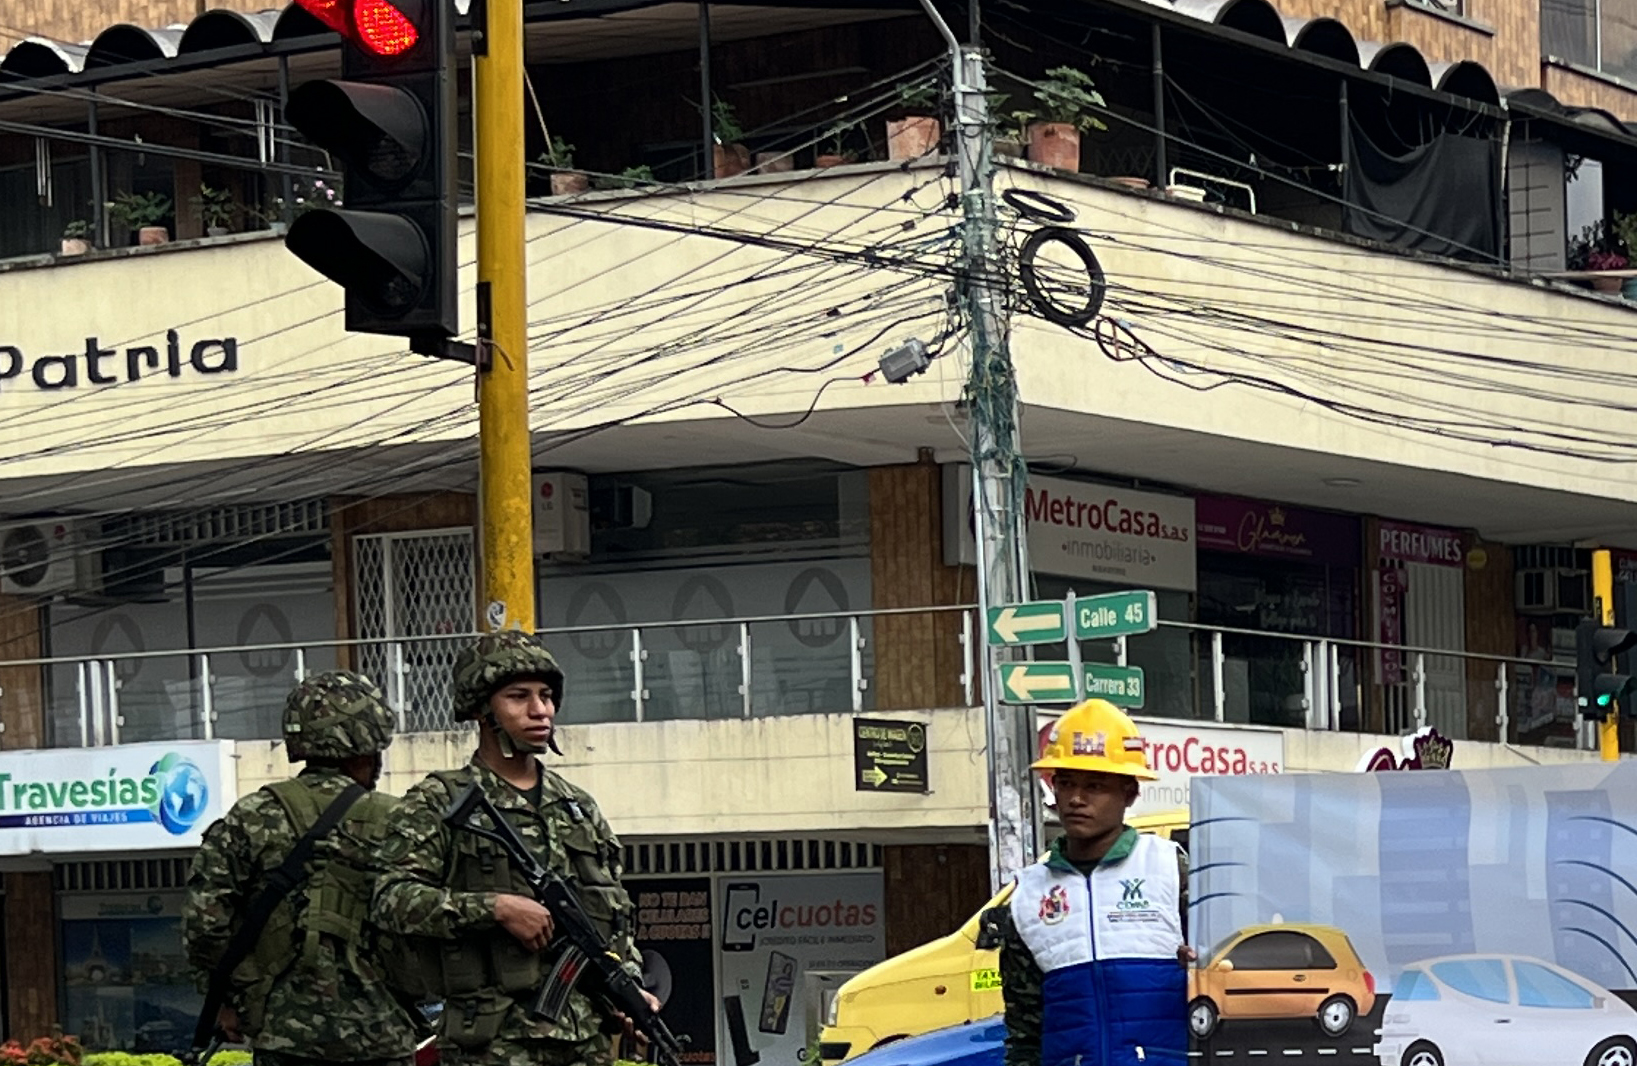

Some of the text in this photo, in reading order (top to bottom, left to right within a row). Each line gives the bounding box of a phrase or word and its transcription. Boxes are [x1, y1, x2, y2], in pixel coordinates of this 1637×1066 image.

[1025, 487, 1161, 538] MetroCasa
[1380, 528, 1462, 562] PERFUMES
[1080, 602, 1144, 629] Calle 45
[1085, 672, 1141, 697] Carrera 33
[24, 811, 128, 827] AGENCIA DE VIAJES
[736, 900, 877, 930] celcuotas
